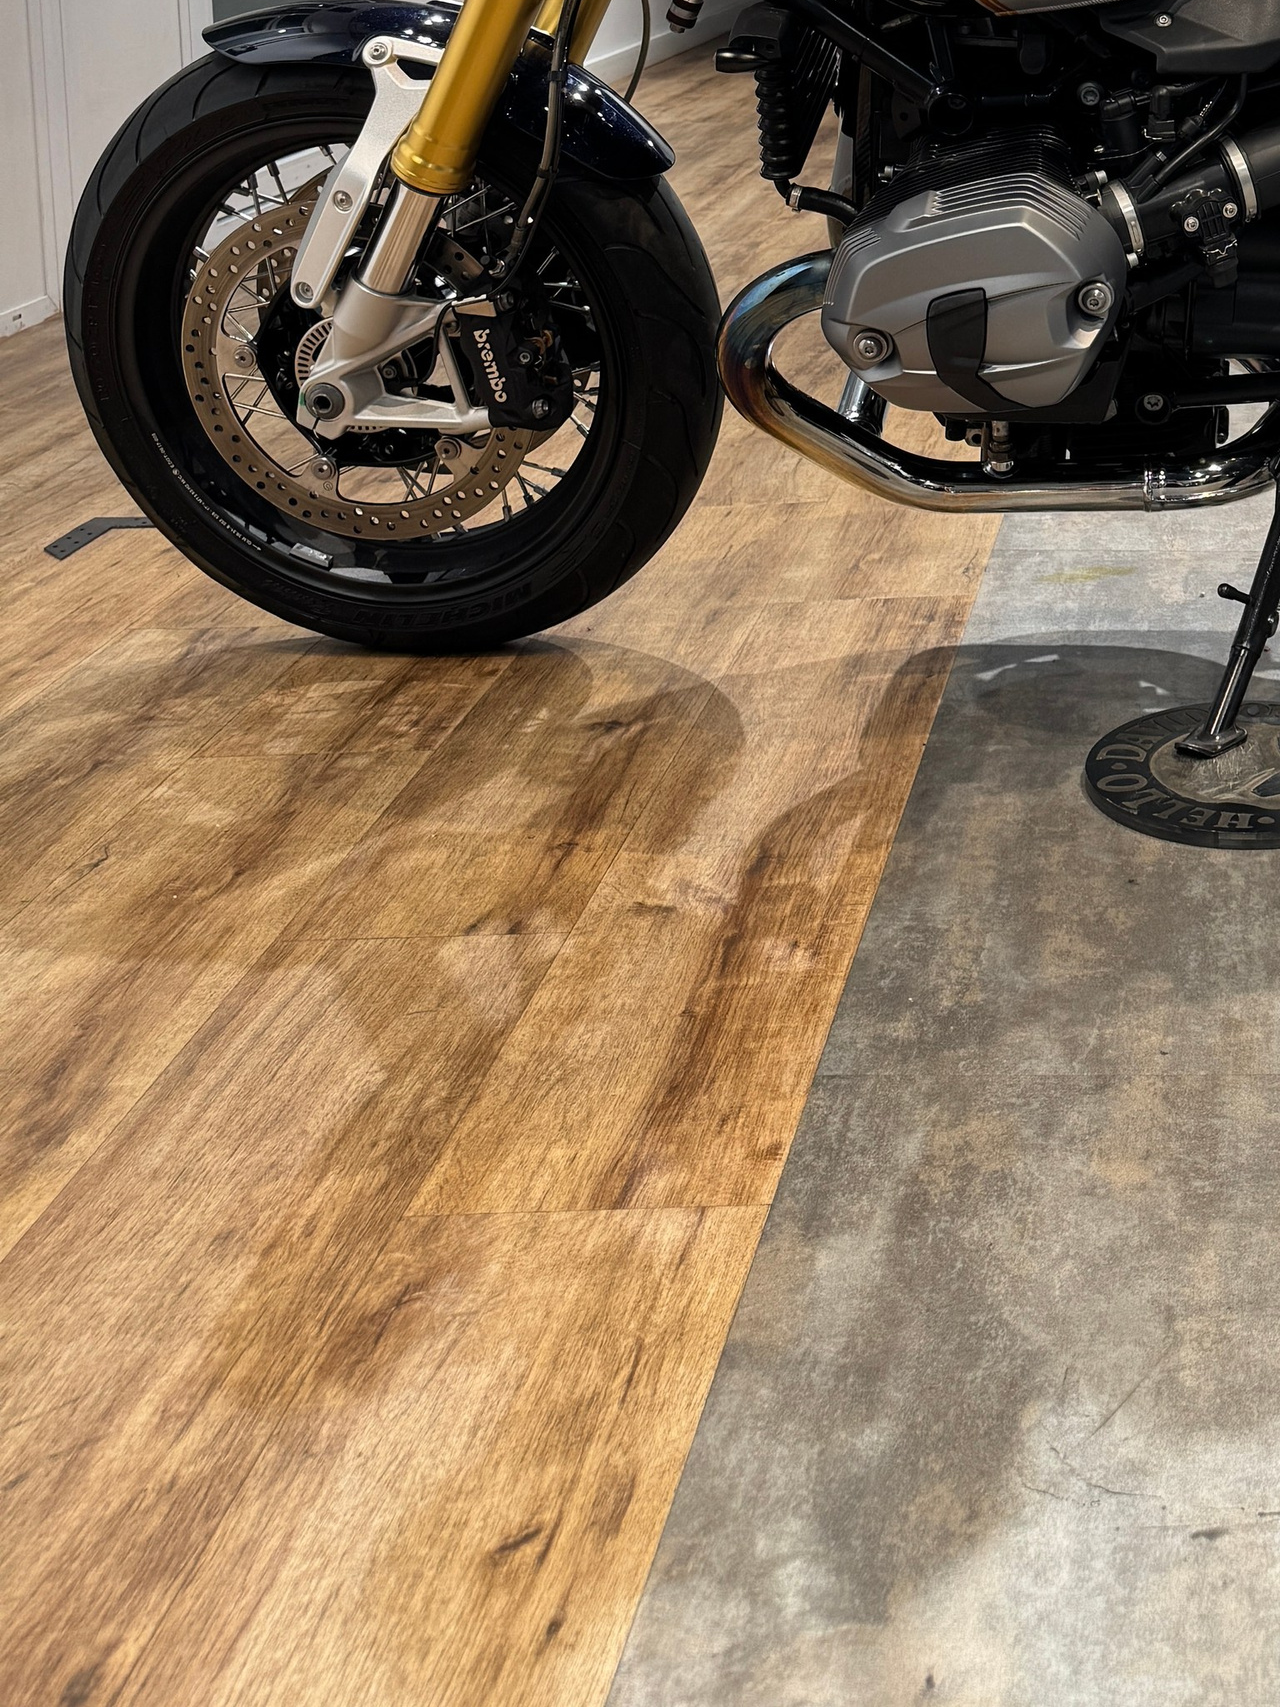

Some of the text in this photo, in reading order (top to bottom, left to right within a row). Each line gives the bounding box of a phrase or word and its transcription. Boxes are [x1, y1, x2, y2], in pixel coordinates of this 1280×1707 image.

[472, 327, 508, 404] brembo
[351, 582, 533, 628] MICHELIN
[1096, 773, 1255, 829] HELLO
